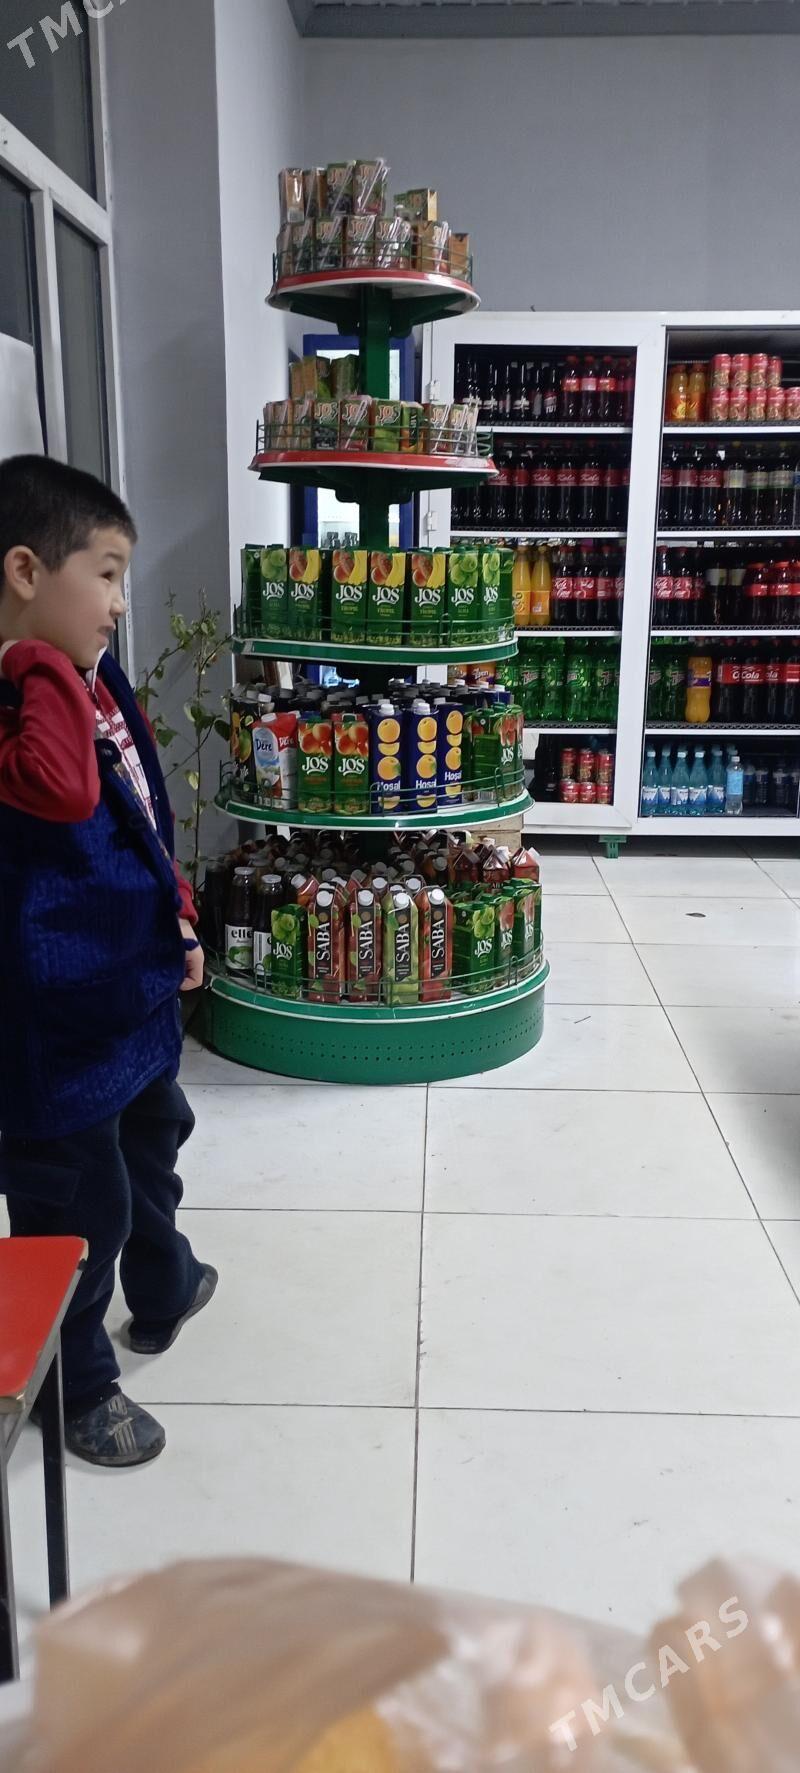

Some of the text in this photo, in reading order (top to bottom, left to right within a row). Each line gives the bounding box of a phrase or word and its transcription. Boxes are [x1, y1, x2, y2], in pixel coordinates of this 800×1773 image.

[262, 582, 285, 600] JOS
[291, 583, 314, 601] JOS
[335, 584, 362, 603] JOS
[372, 587, 400, 606] JOS
[414, 588, 441, 607] JOS
[451, 587, 475, 607] JOS
[483, 586, 499, 605] JOS
[302, 756, 329, 774] JOS
[338, 758, 365, 776] JOS
[316, 922, 331, 961] SABA
[359, 920, 373, 960] SABA
[396, 923, 410, 963] SABA
[431, 919, 445, 959] SABA
[474, 938, 493, 958] JOS
[273, 942, 293, 960] JOS
